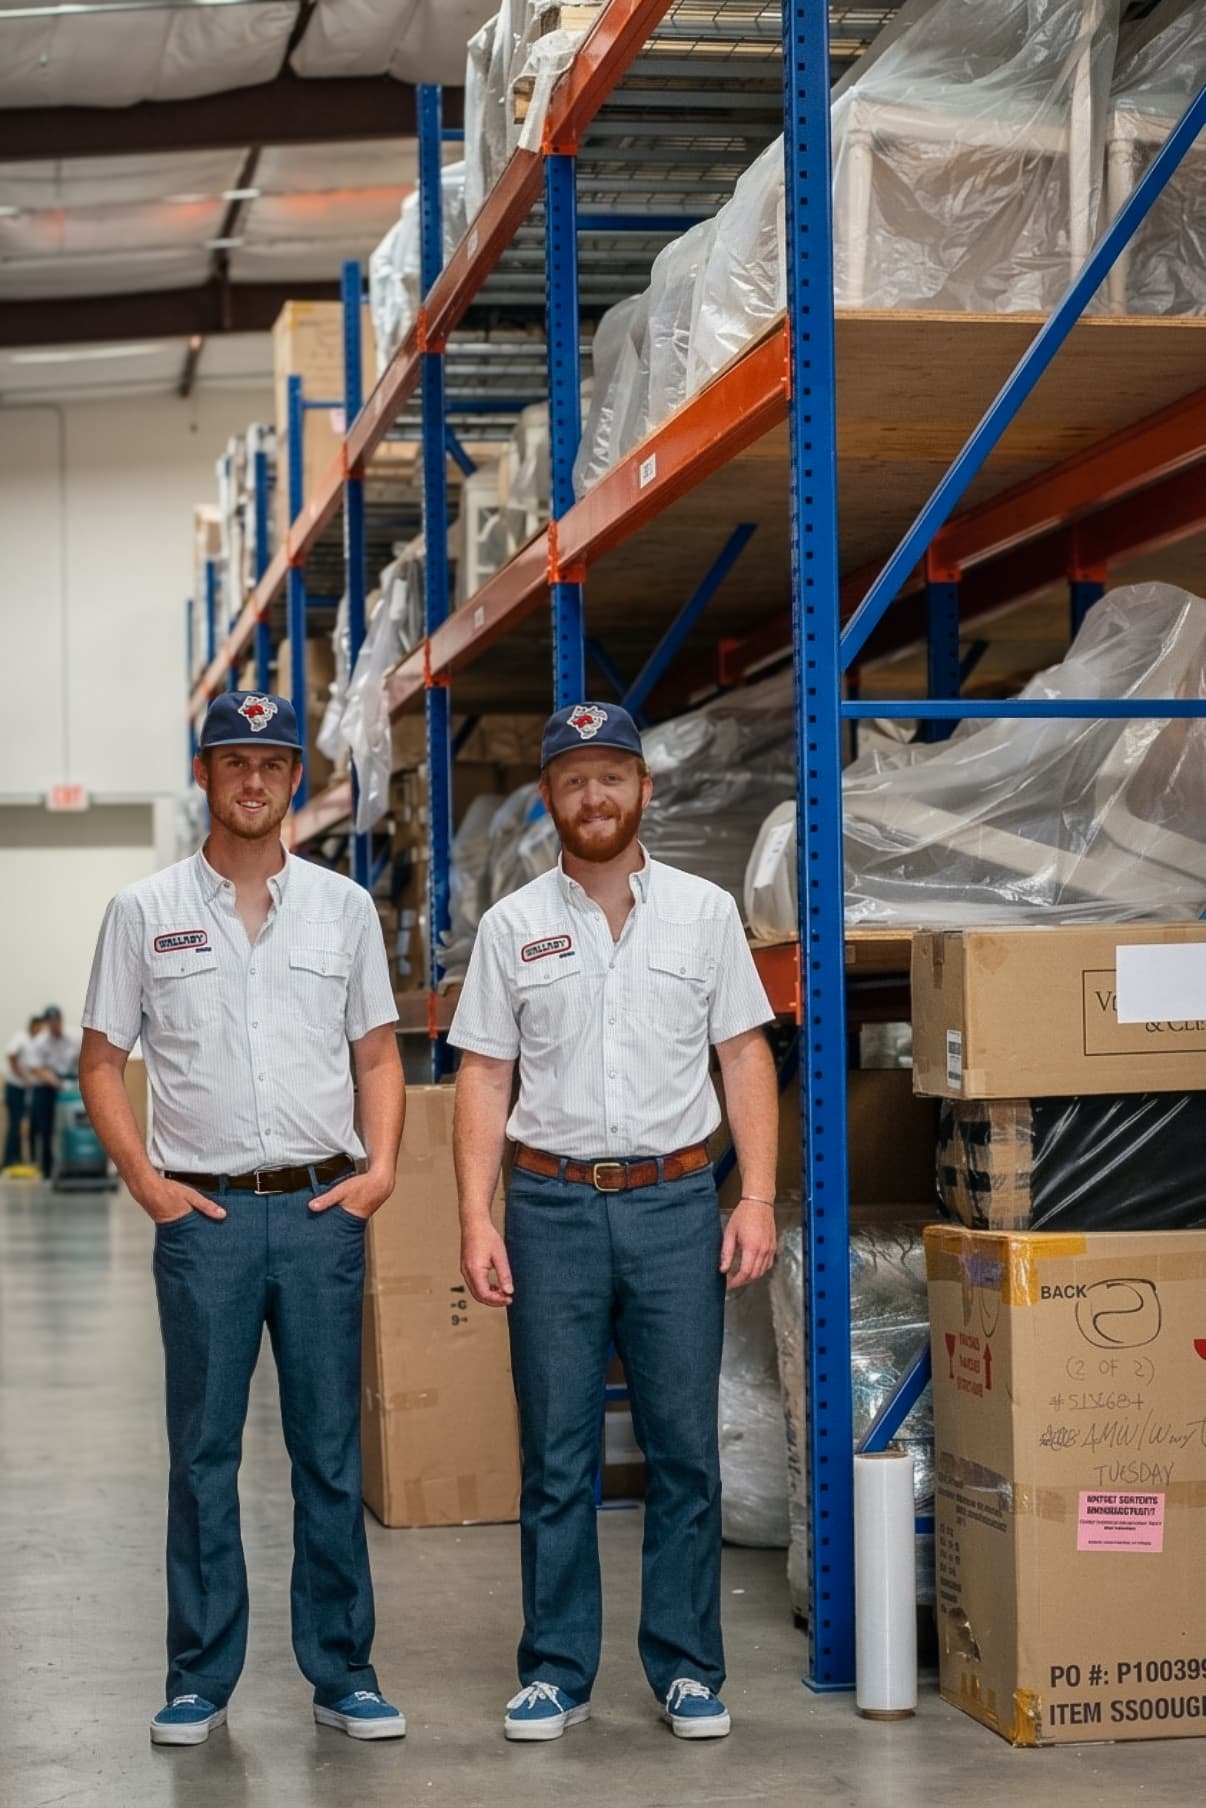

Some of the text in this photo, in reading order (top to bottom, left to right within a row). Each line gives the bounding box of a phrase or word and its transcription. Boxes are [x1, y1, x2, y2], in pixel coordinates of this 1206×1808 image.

[159, 934, 203, 949] WALLABY
[1040, 1284, 1088, 1300] BACK
[1098, 1358, 1120, 1378] OF
[1093, 1460, 1175, 1487] TUESDAY
[1050, 1664, 1081, 1688] PO
[1088, 1663, 1109, 1686] #:
[1050, 1702, 1102, 1726] ITEM
